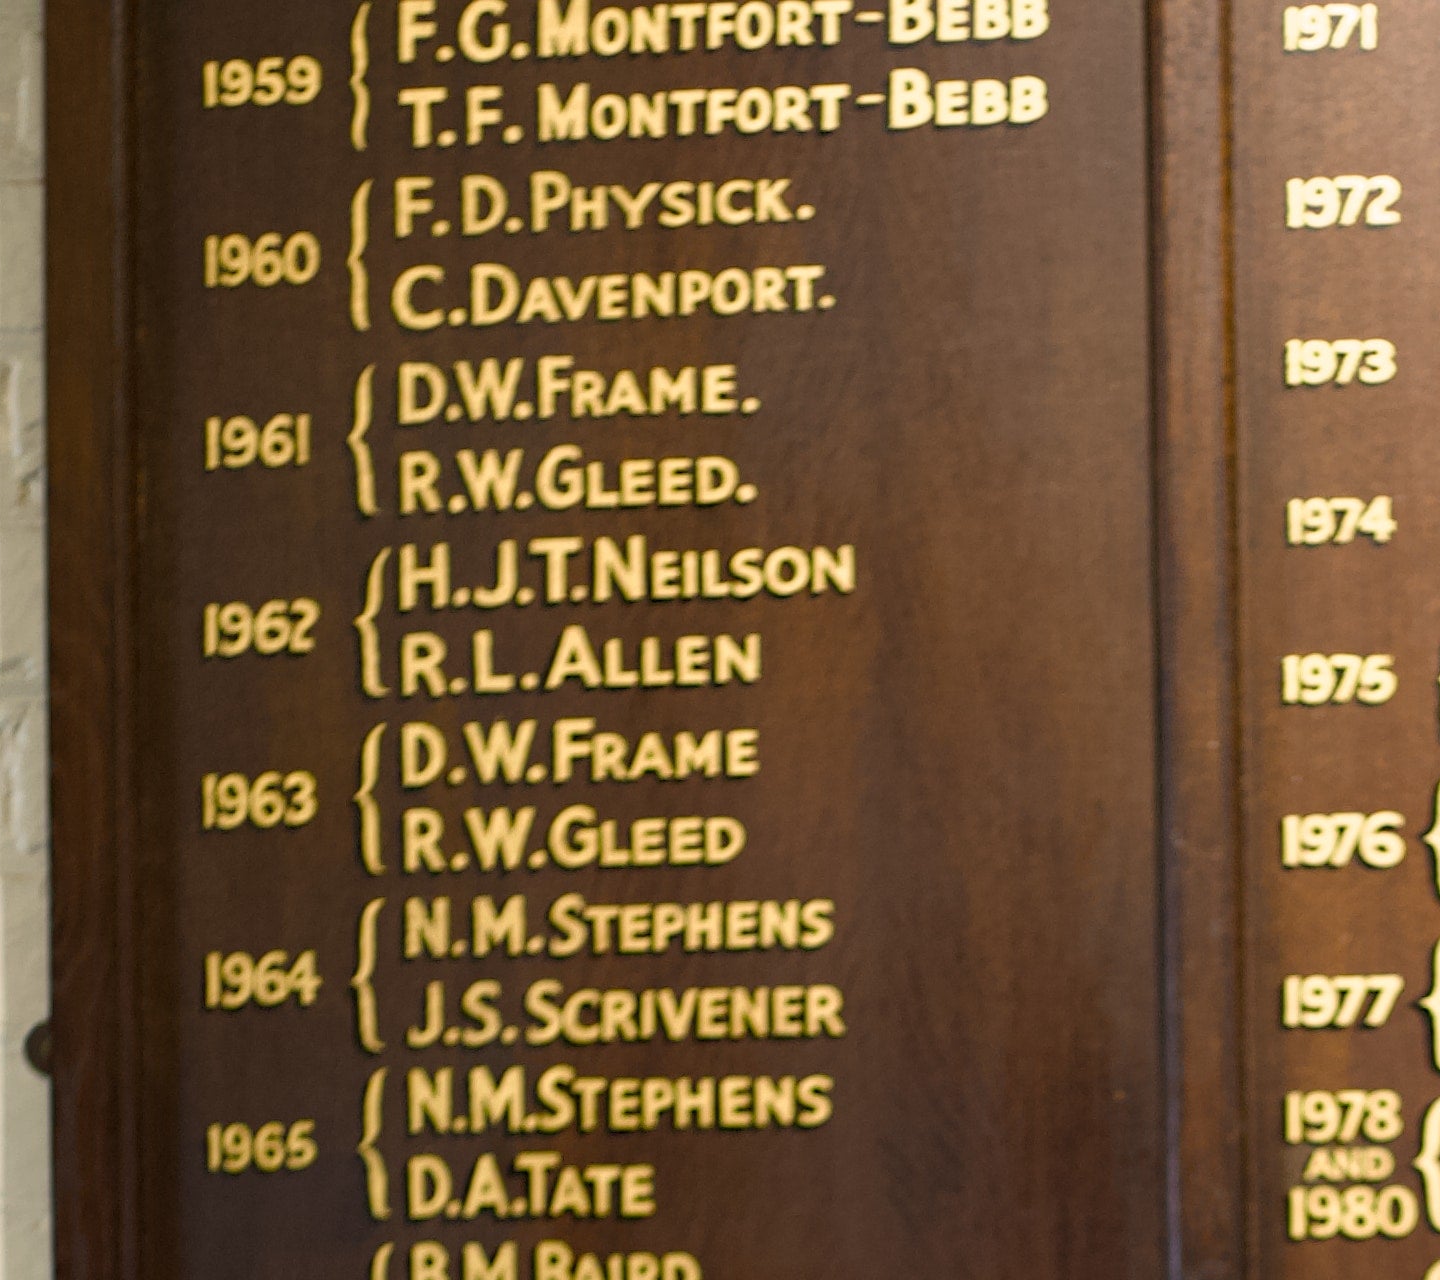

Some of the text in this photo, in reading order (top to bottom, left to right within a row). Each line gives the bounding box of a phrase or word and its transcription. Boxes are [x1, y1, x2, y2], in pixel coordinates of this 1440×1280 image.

[1284, 3, 1378, 51] 1971
[205, 56, 321, 107] 1959
[1286, 175, 1401, 228] 1972
[206, 233, 319, 287] 1960
[1286, 338, 1397, 385] 1973
[208, 414, 309, 469] 1961
[1288, 496, 1396, 544] 1974
[206, 598, 319, 656] 1962
[1283, 654, 1396, 703] 1975
[205, 772, 316, 828] 1963
[1284, 811, 1404, 867] 1976
[208, 951, 321, 1006] 1964
[1285, 974, 1403, 1027] 1977
[1288, 1090, 1401, 1142] 1978
[208, 1122, 316, 1169] 1965
[1306, 1147, 1392, 1180] AND
[1291, 1186, 1416, 1237] 1980
